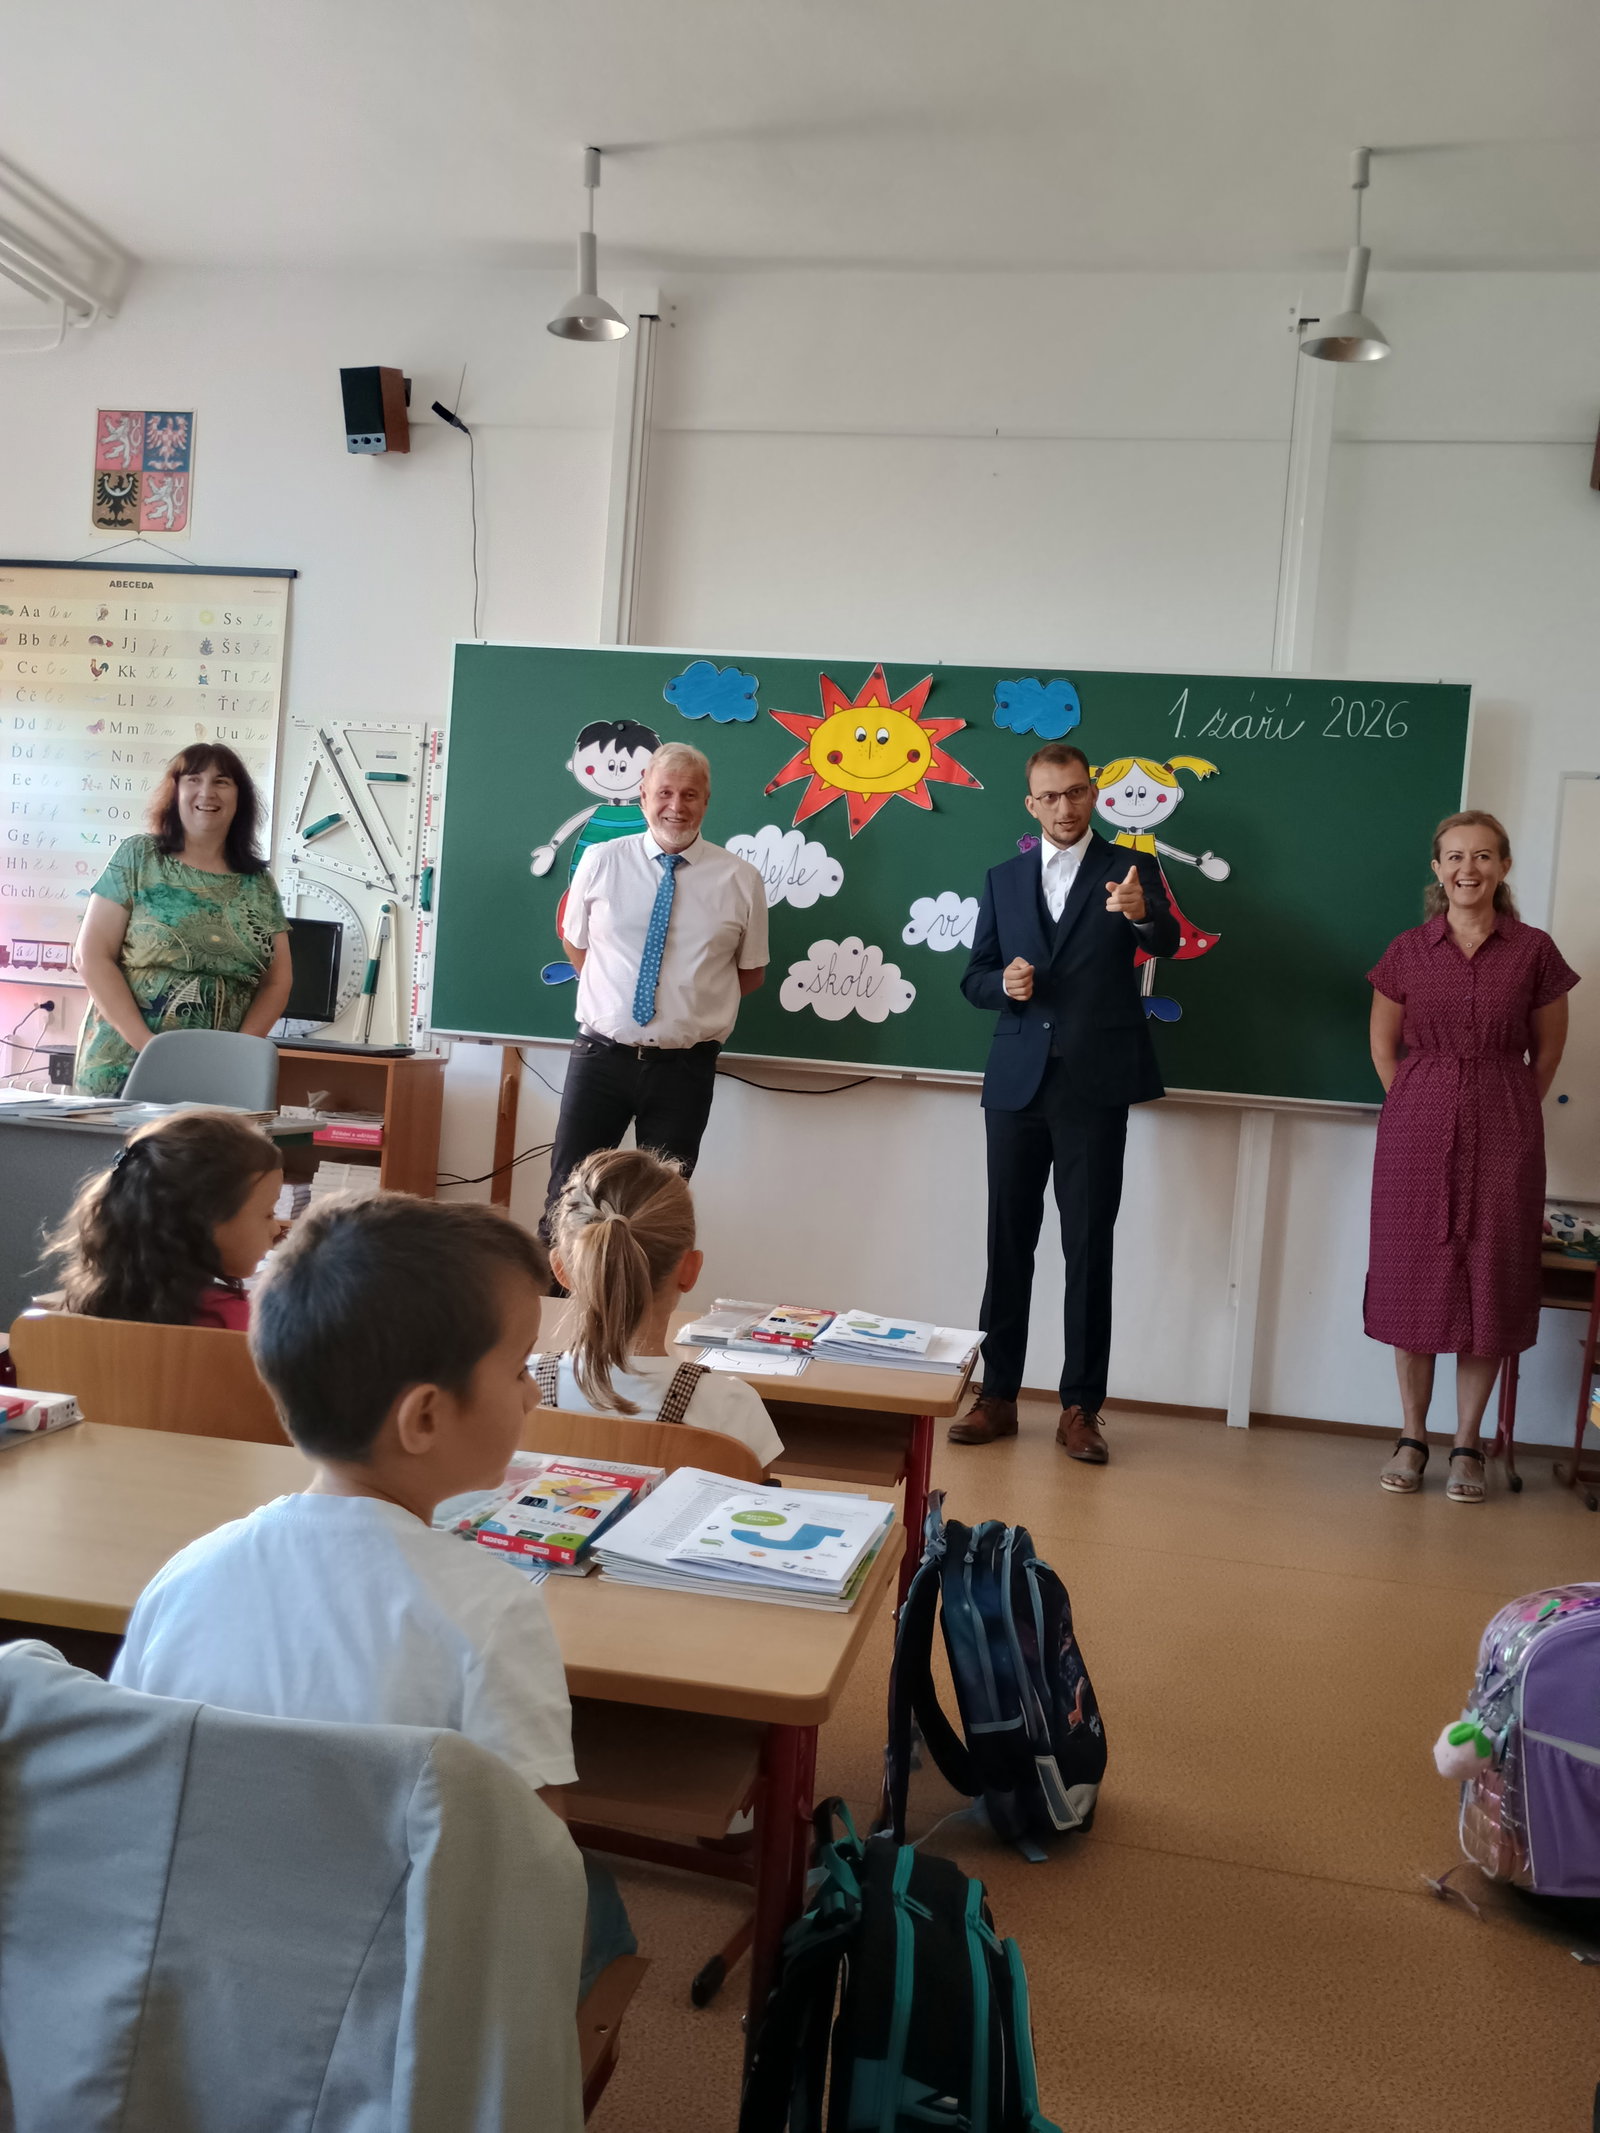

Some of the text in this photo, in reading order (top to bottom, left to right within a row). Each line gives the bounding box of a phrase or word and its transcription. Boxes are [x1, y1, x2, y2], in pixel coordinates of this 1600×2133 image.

[109, 580, 154, 589] ABECEDA
[1168, 687, 1410, 740] 1. září 2026
[1, 884, 18, 897] Ch
[21, 885, 35, 898] ch
[805, 951, 885, 999] škole
